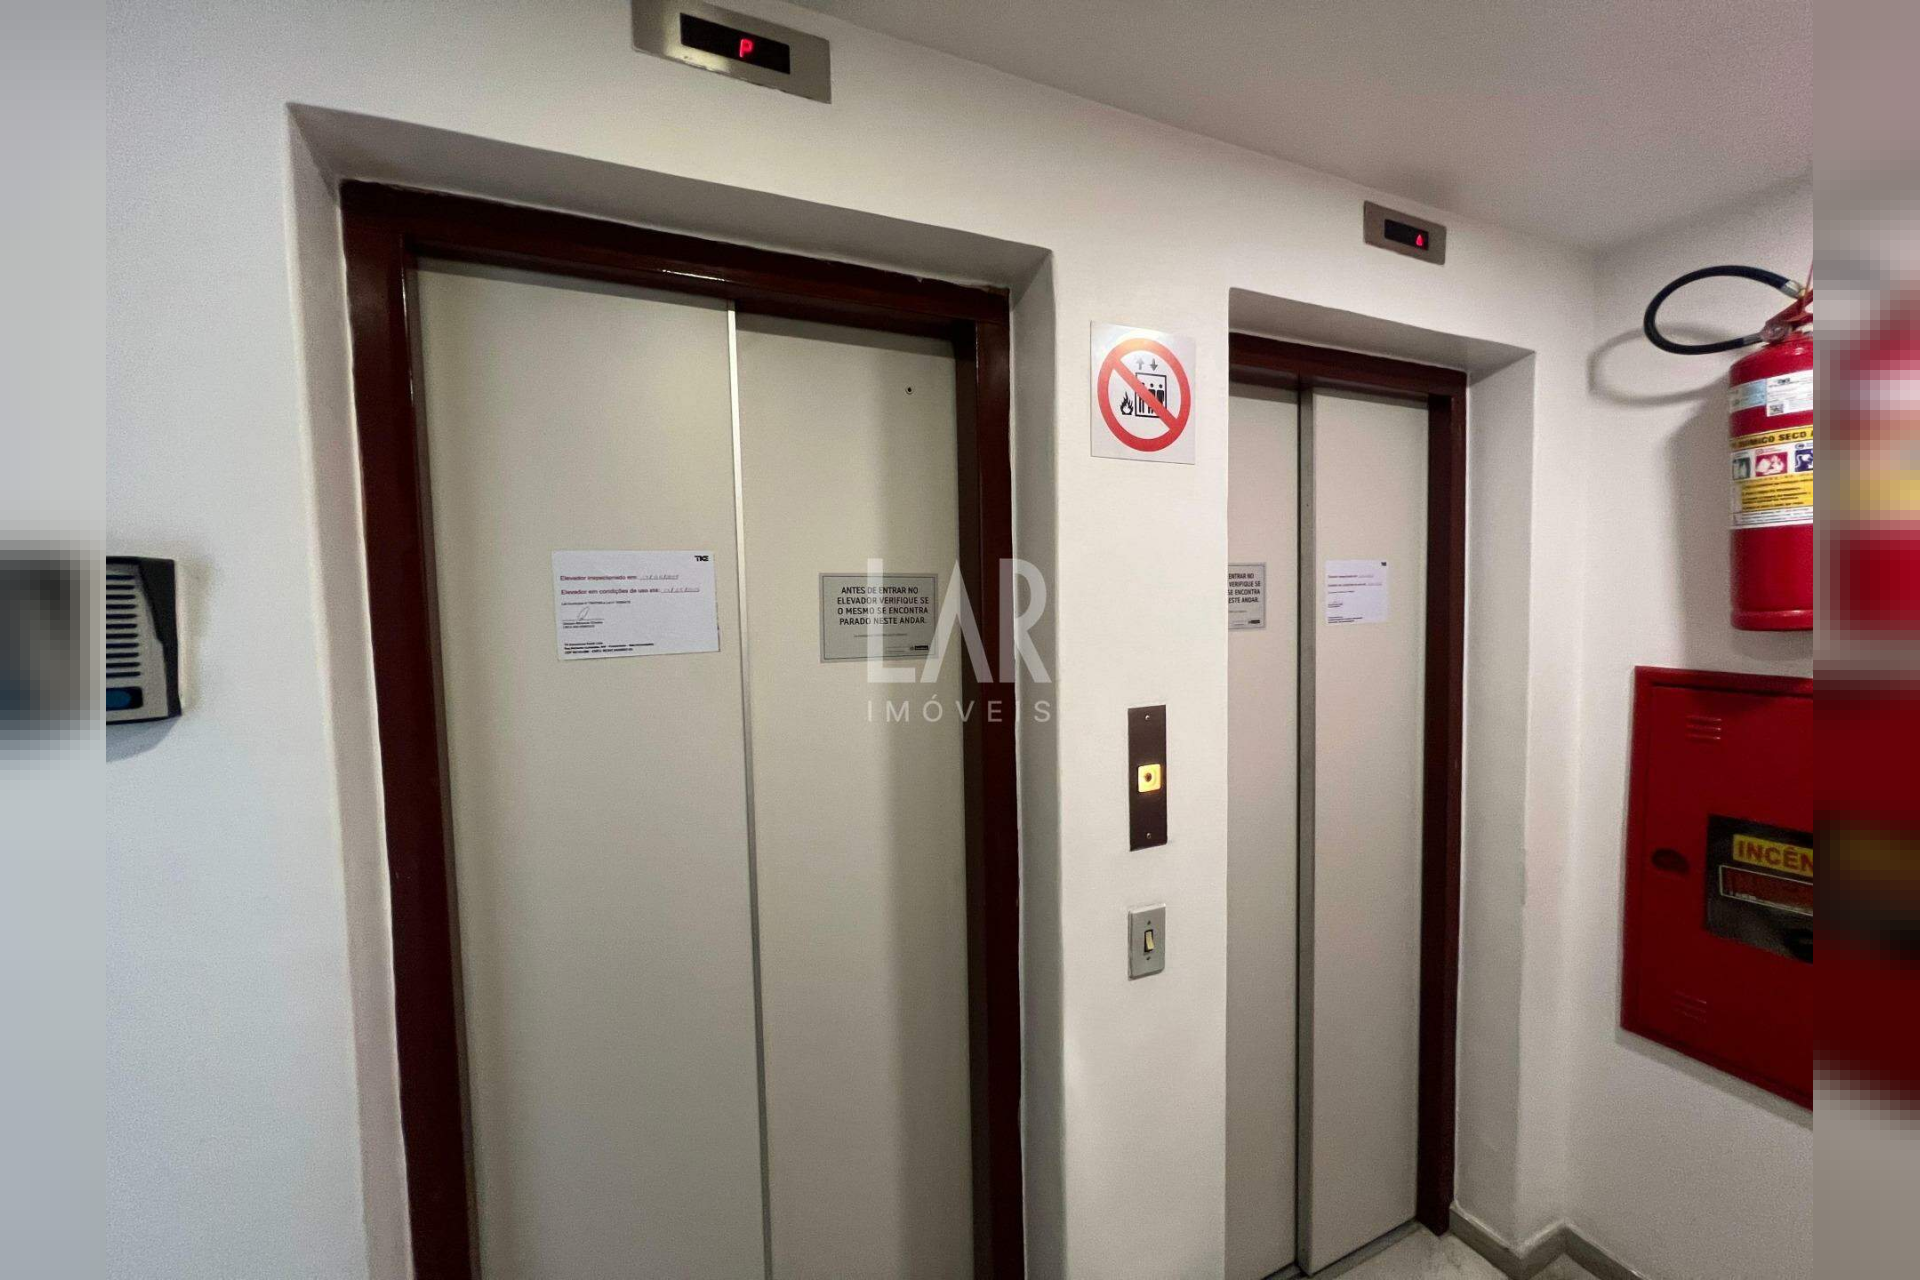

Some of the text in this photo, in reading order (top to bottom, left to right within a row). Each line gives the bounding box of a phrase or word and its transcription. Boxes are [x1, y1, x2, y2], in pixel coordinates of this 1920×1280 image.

[739, 38, 753, 58] P
[1778, 431, 1807, 440] SECO
[841, 586, 919, 594] ANTES DE ENTRAR NO
[837, 596, 929, 605] ELEVADOR VERIFIQUE SE
[837, 607, 843, 615] O
[889, 606, 928, 614] ENCONTRA
[839, 617, 871, 625] PARADO
